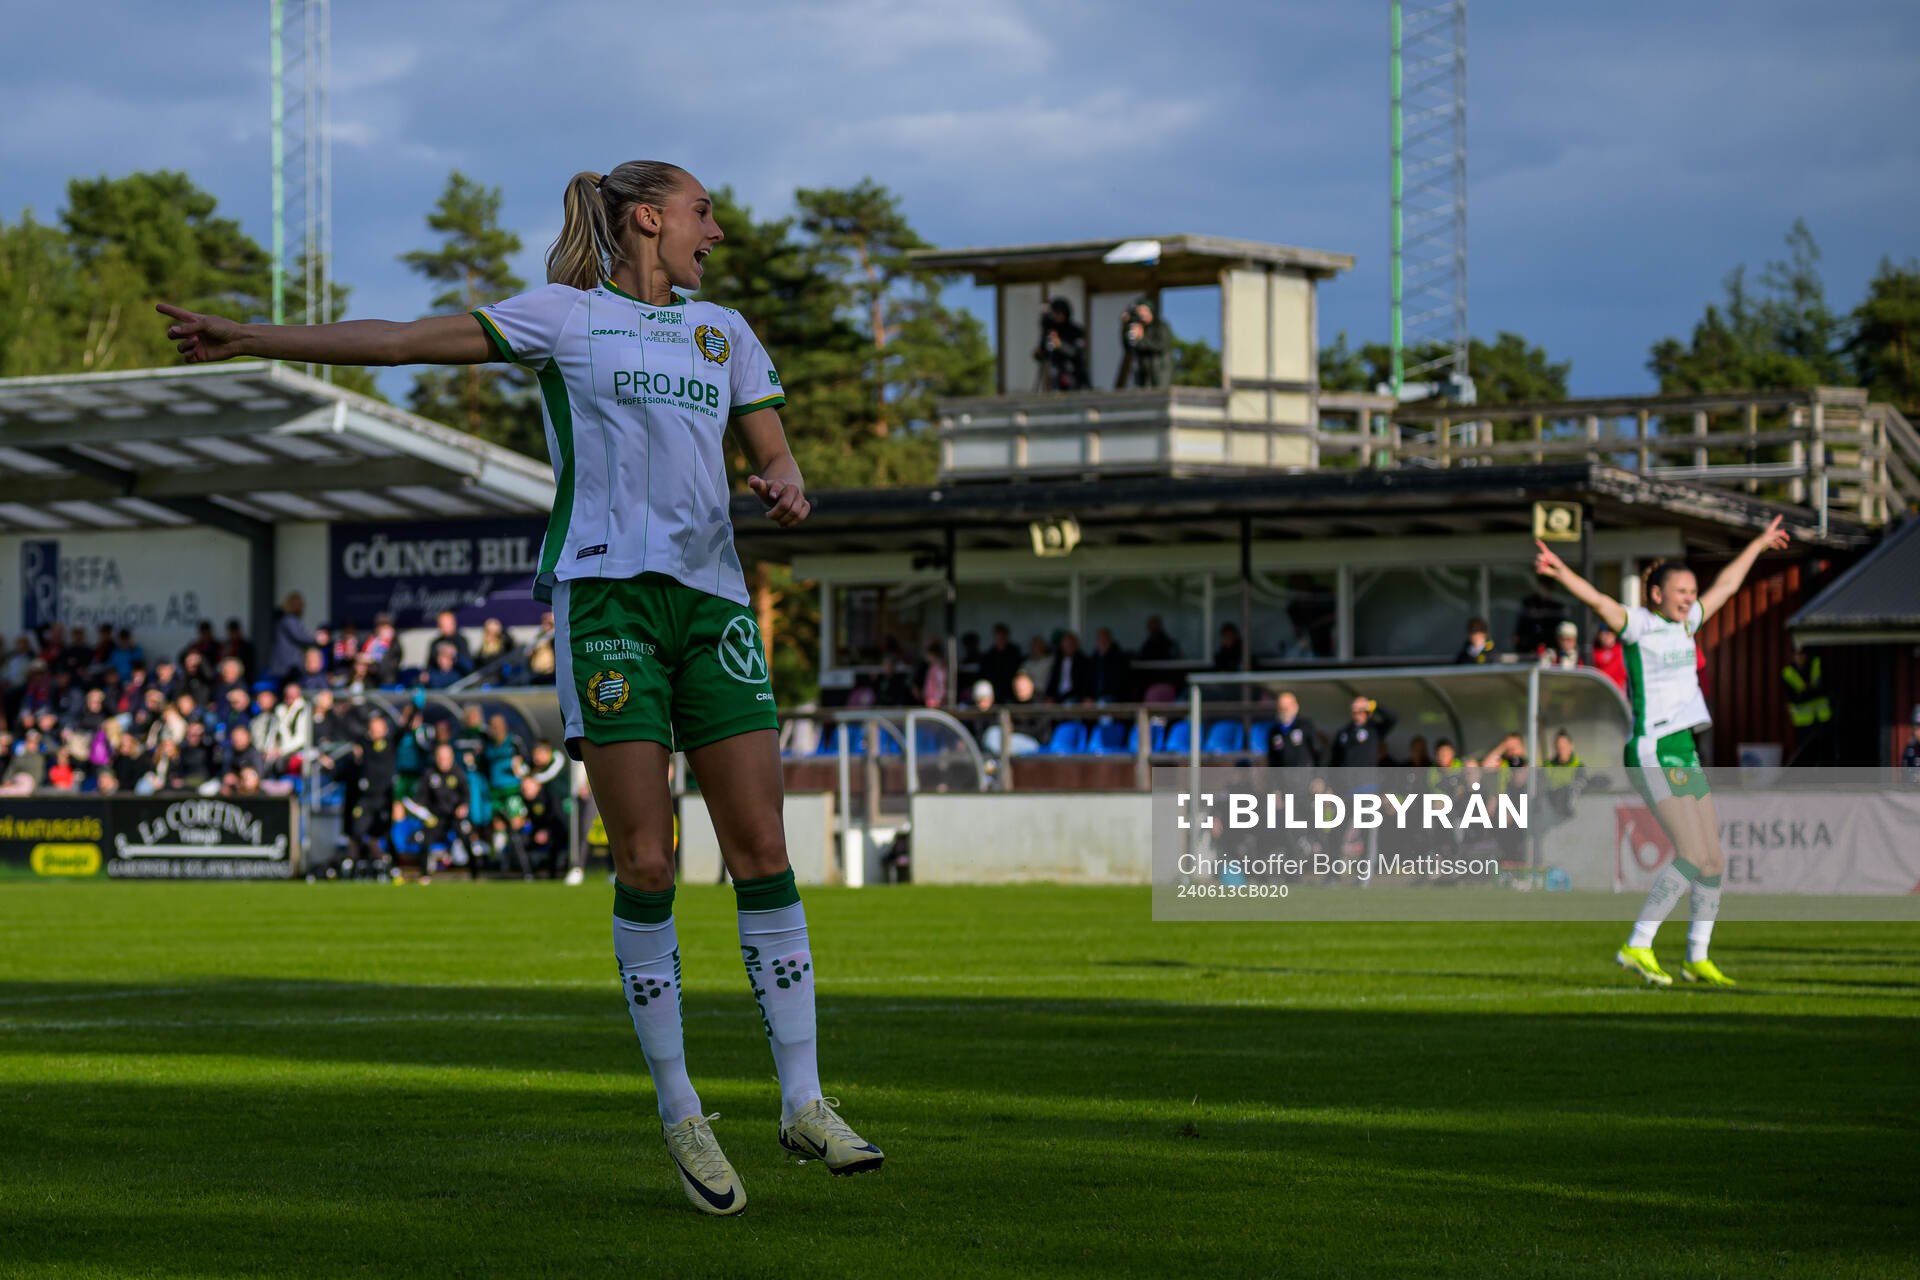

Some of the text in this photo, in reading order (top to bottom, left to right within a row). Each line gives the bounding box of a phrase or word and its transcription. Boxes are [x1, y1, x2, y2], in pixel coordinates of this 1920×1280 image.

[656, 310, 682, 319] INTER
[657, 317, 682, 325] SPORT
[644, 336, 690, 344] WELLNESS
[650, 330, 682, 338] NORDIC
[613, 370, 720, 409] PROJOB
[616, 396, 718, 419] PROFESSIONAL WORKWEAR
[343, 533, 472, 579] GÖINGE
[166, 800, 263, 845] CORTINA
[1718, 819, 1833, 850] VENSKA
[1727, 854, 1763, 883] EL
